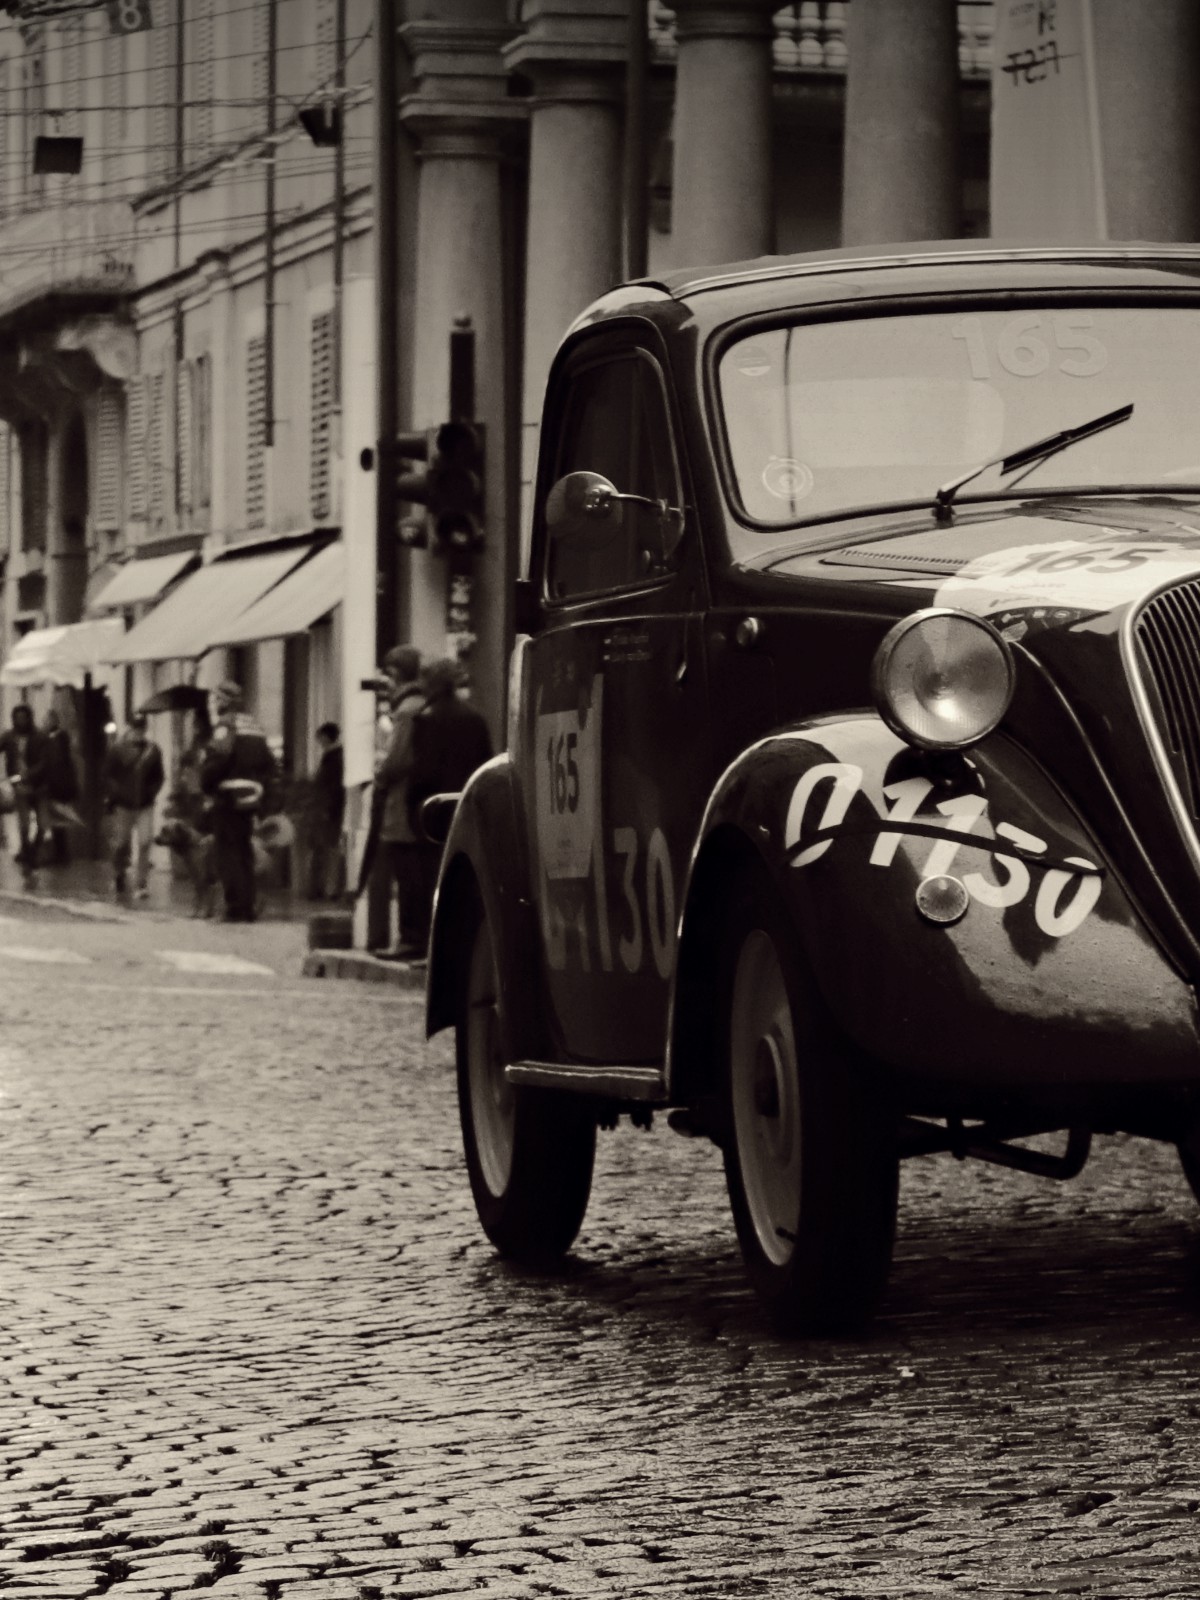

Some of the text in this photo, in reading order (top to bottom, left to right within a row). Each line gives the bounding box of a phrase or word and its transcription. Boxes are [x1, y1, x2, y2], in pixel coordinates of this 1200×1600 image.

[951, 313, 1108, 380] 165
[1002, 547, 1167, 577] 165
[547, 732, 579, 815] 165
